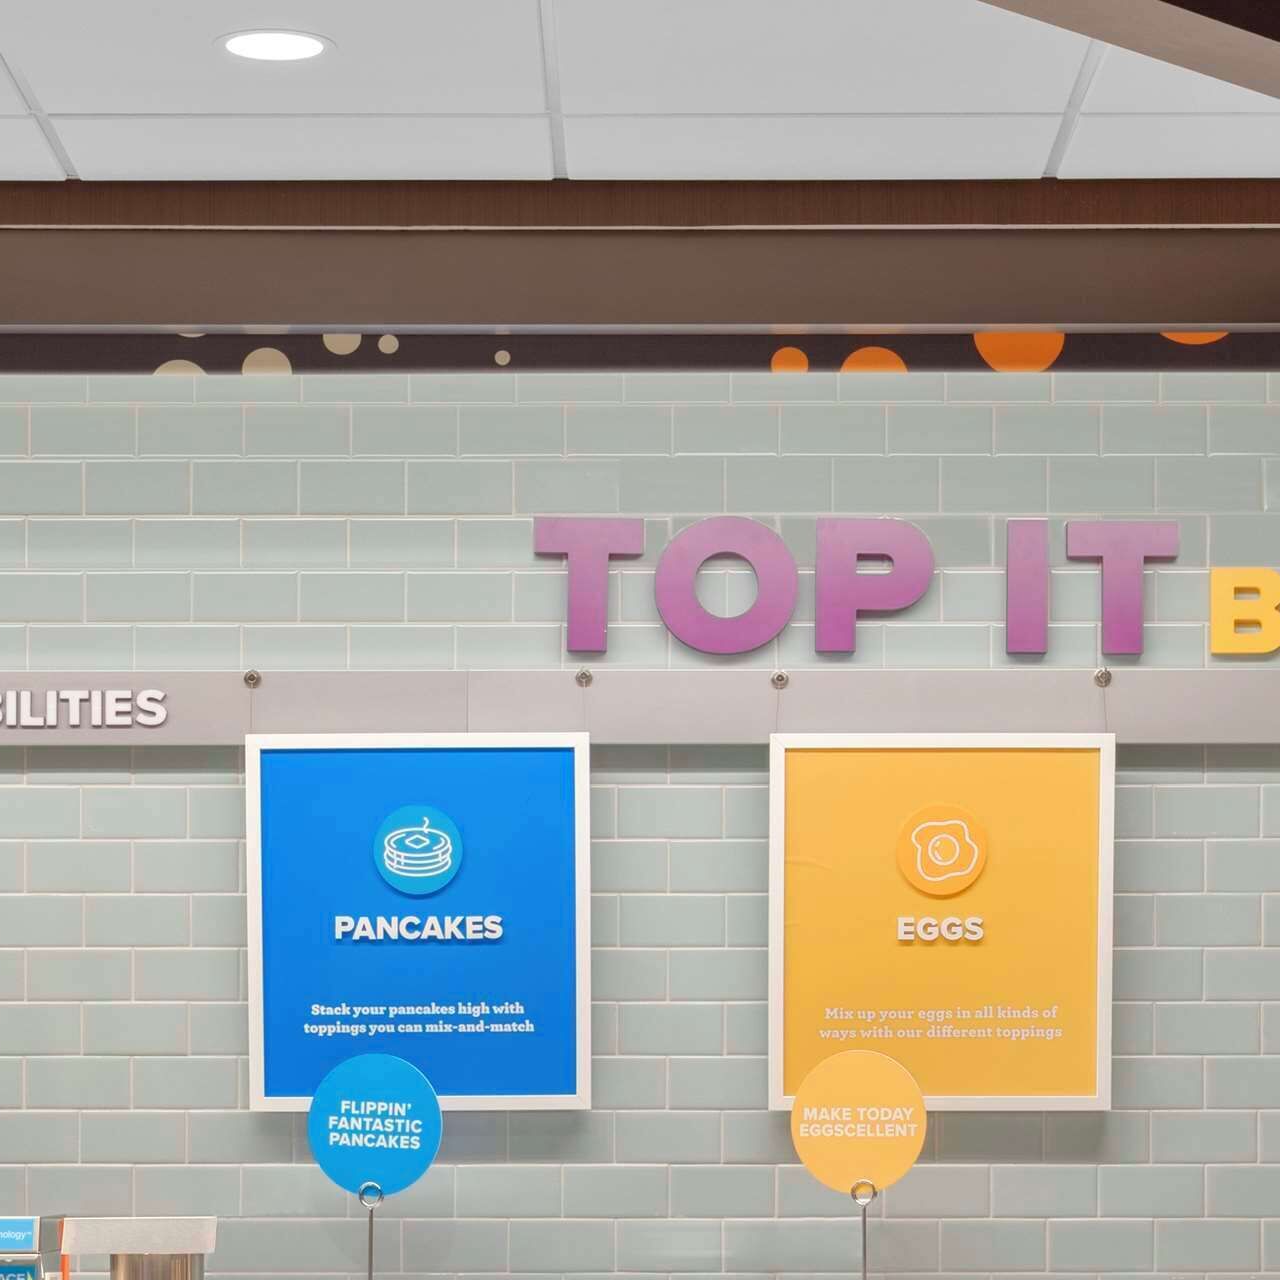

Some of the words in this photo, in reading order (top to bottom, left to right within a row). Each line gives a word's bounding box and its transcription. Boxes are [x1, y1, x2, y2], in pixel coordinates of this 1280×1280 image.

[533, 516, 935, 655] TOP
[1006, 518, 1179, 655] IT
[334, 915, 504, 942] PANCAKES
[896, 916, 984, 942] EGGS
[311, 1003, 351, 1016] Stack
[352, 1005, 386, 1018] your
[388, 1002, 455, 1018] pancakes
[458, 1002, 490, 1017] high
[492, 1002, 525, 1015] with
[824, 1007, 853, 1019] Mix
[857, 1009, 875, 1022] up
[879, 1009, 914, 1022] your
[918, 1009, 953, 1022] eggs
[956, 1007, 971, 1018] in
[975, 1006, 993, 1018] all
[997, 1006, 1039, 1018] kinds
[1042, 1006, 1059, 1018] of
[304, 1021, 367, 1036] toppings
[369, 1023, 396, 1036] you
[397, 1024, 423, 1033] can
[425, 1020, 535, 1033] mix-and-match
[819, 1028, 857, 1040] ways
[860, 1026, 893, 1038] with
[896, 1028, 923, 1038] our
[926, 1026, 993, 1038] different
[996, 1026, 1062, 1040] toppings
[340, 1100, 412, 1116] FLIPPIN'
[803, 1107, 852, 1121] MAKE
[856, 1107, 915, 1121] TODAY
[328, 1116, 423, 1133] FANTASTIC
[799, 1123, 918, 1137] EGGSCELLENT
[328, 1132, 421, 1150] PANCAKES
